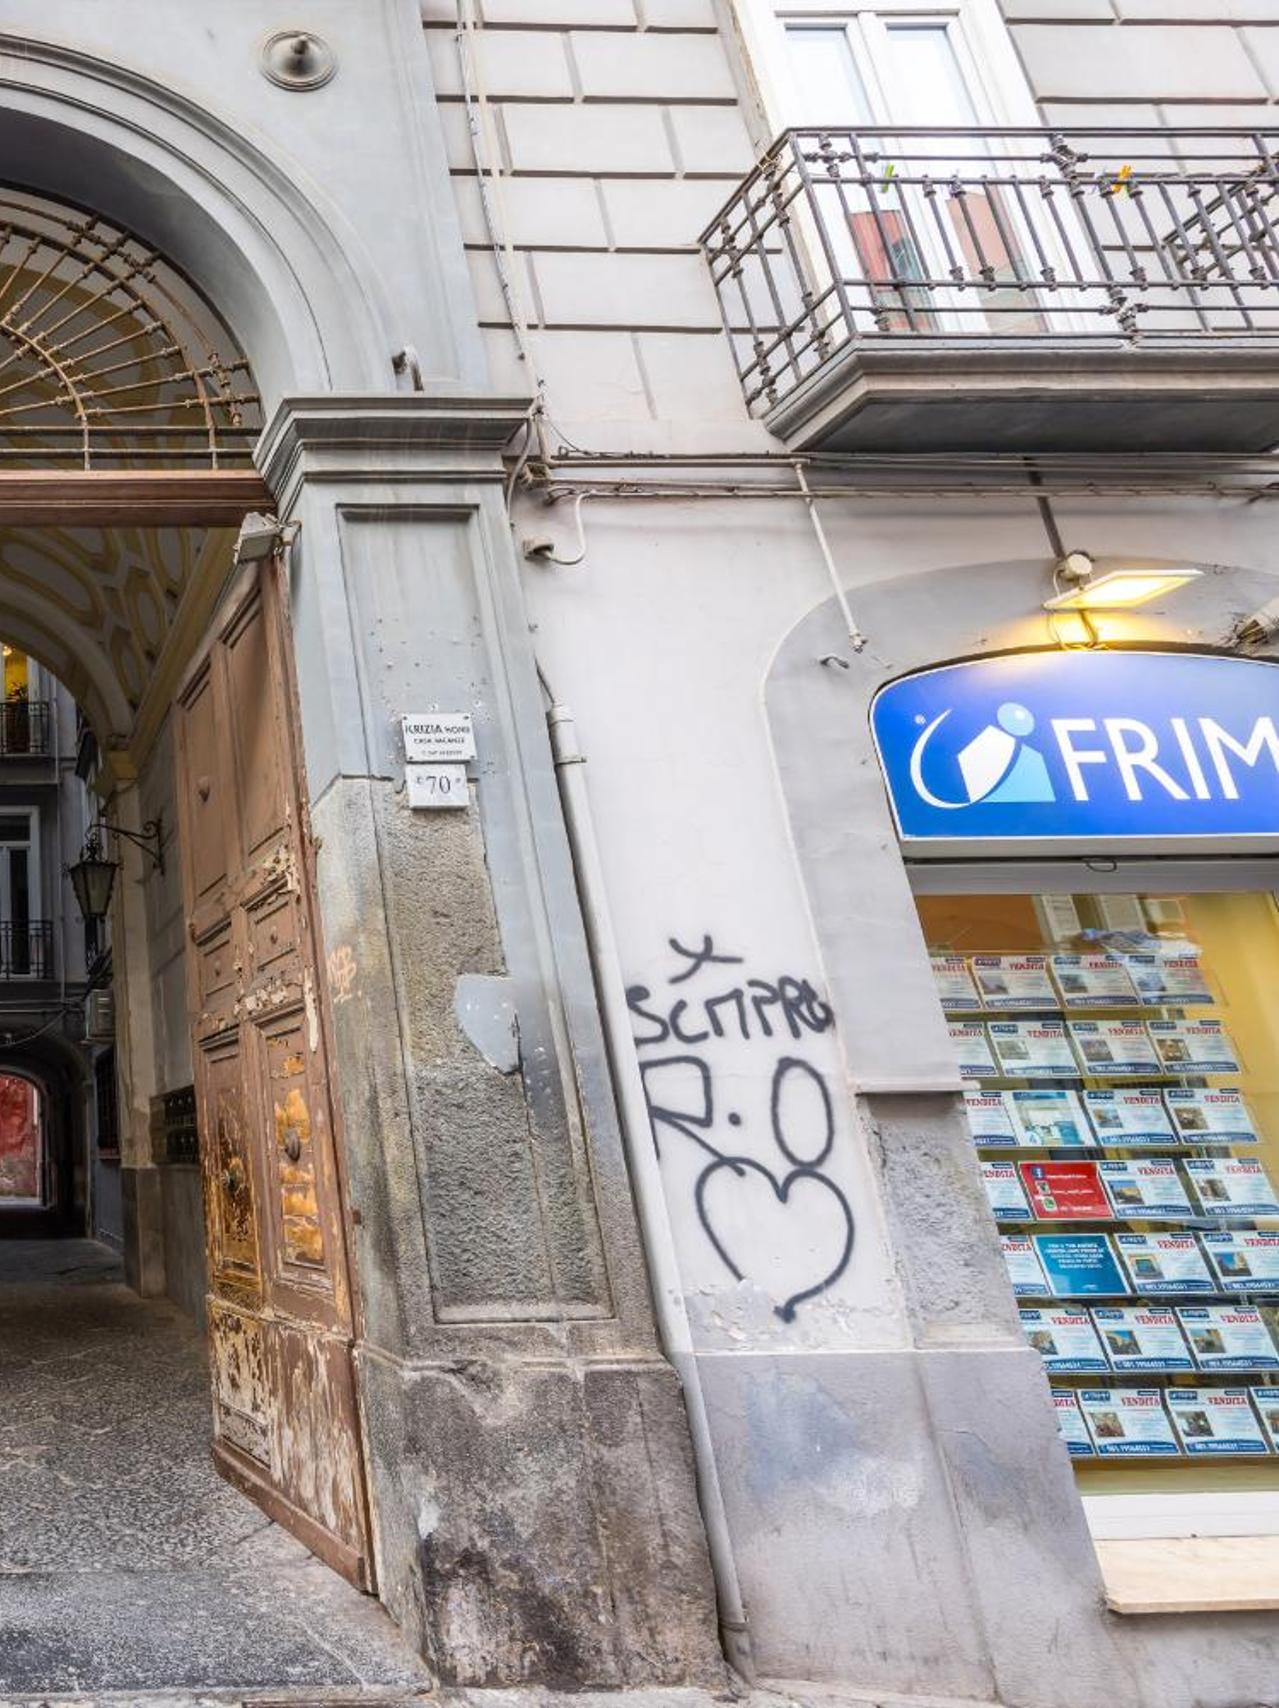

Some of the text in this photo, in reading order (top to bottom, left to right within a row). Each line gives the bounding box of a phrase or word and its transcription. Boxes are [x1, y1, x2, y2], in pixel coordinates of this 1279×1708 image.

[425, 775, 451, 794] 70
[1121, 1397, 1161, 1406] VENDITA
[1208, 1397, 1247, 1405] VENDITA
